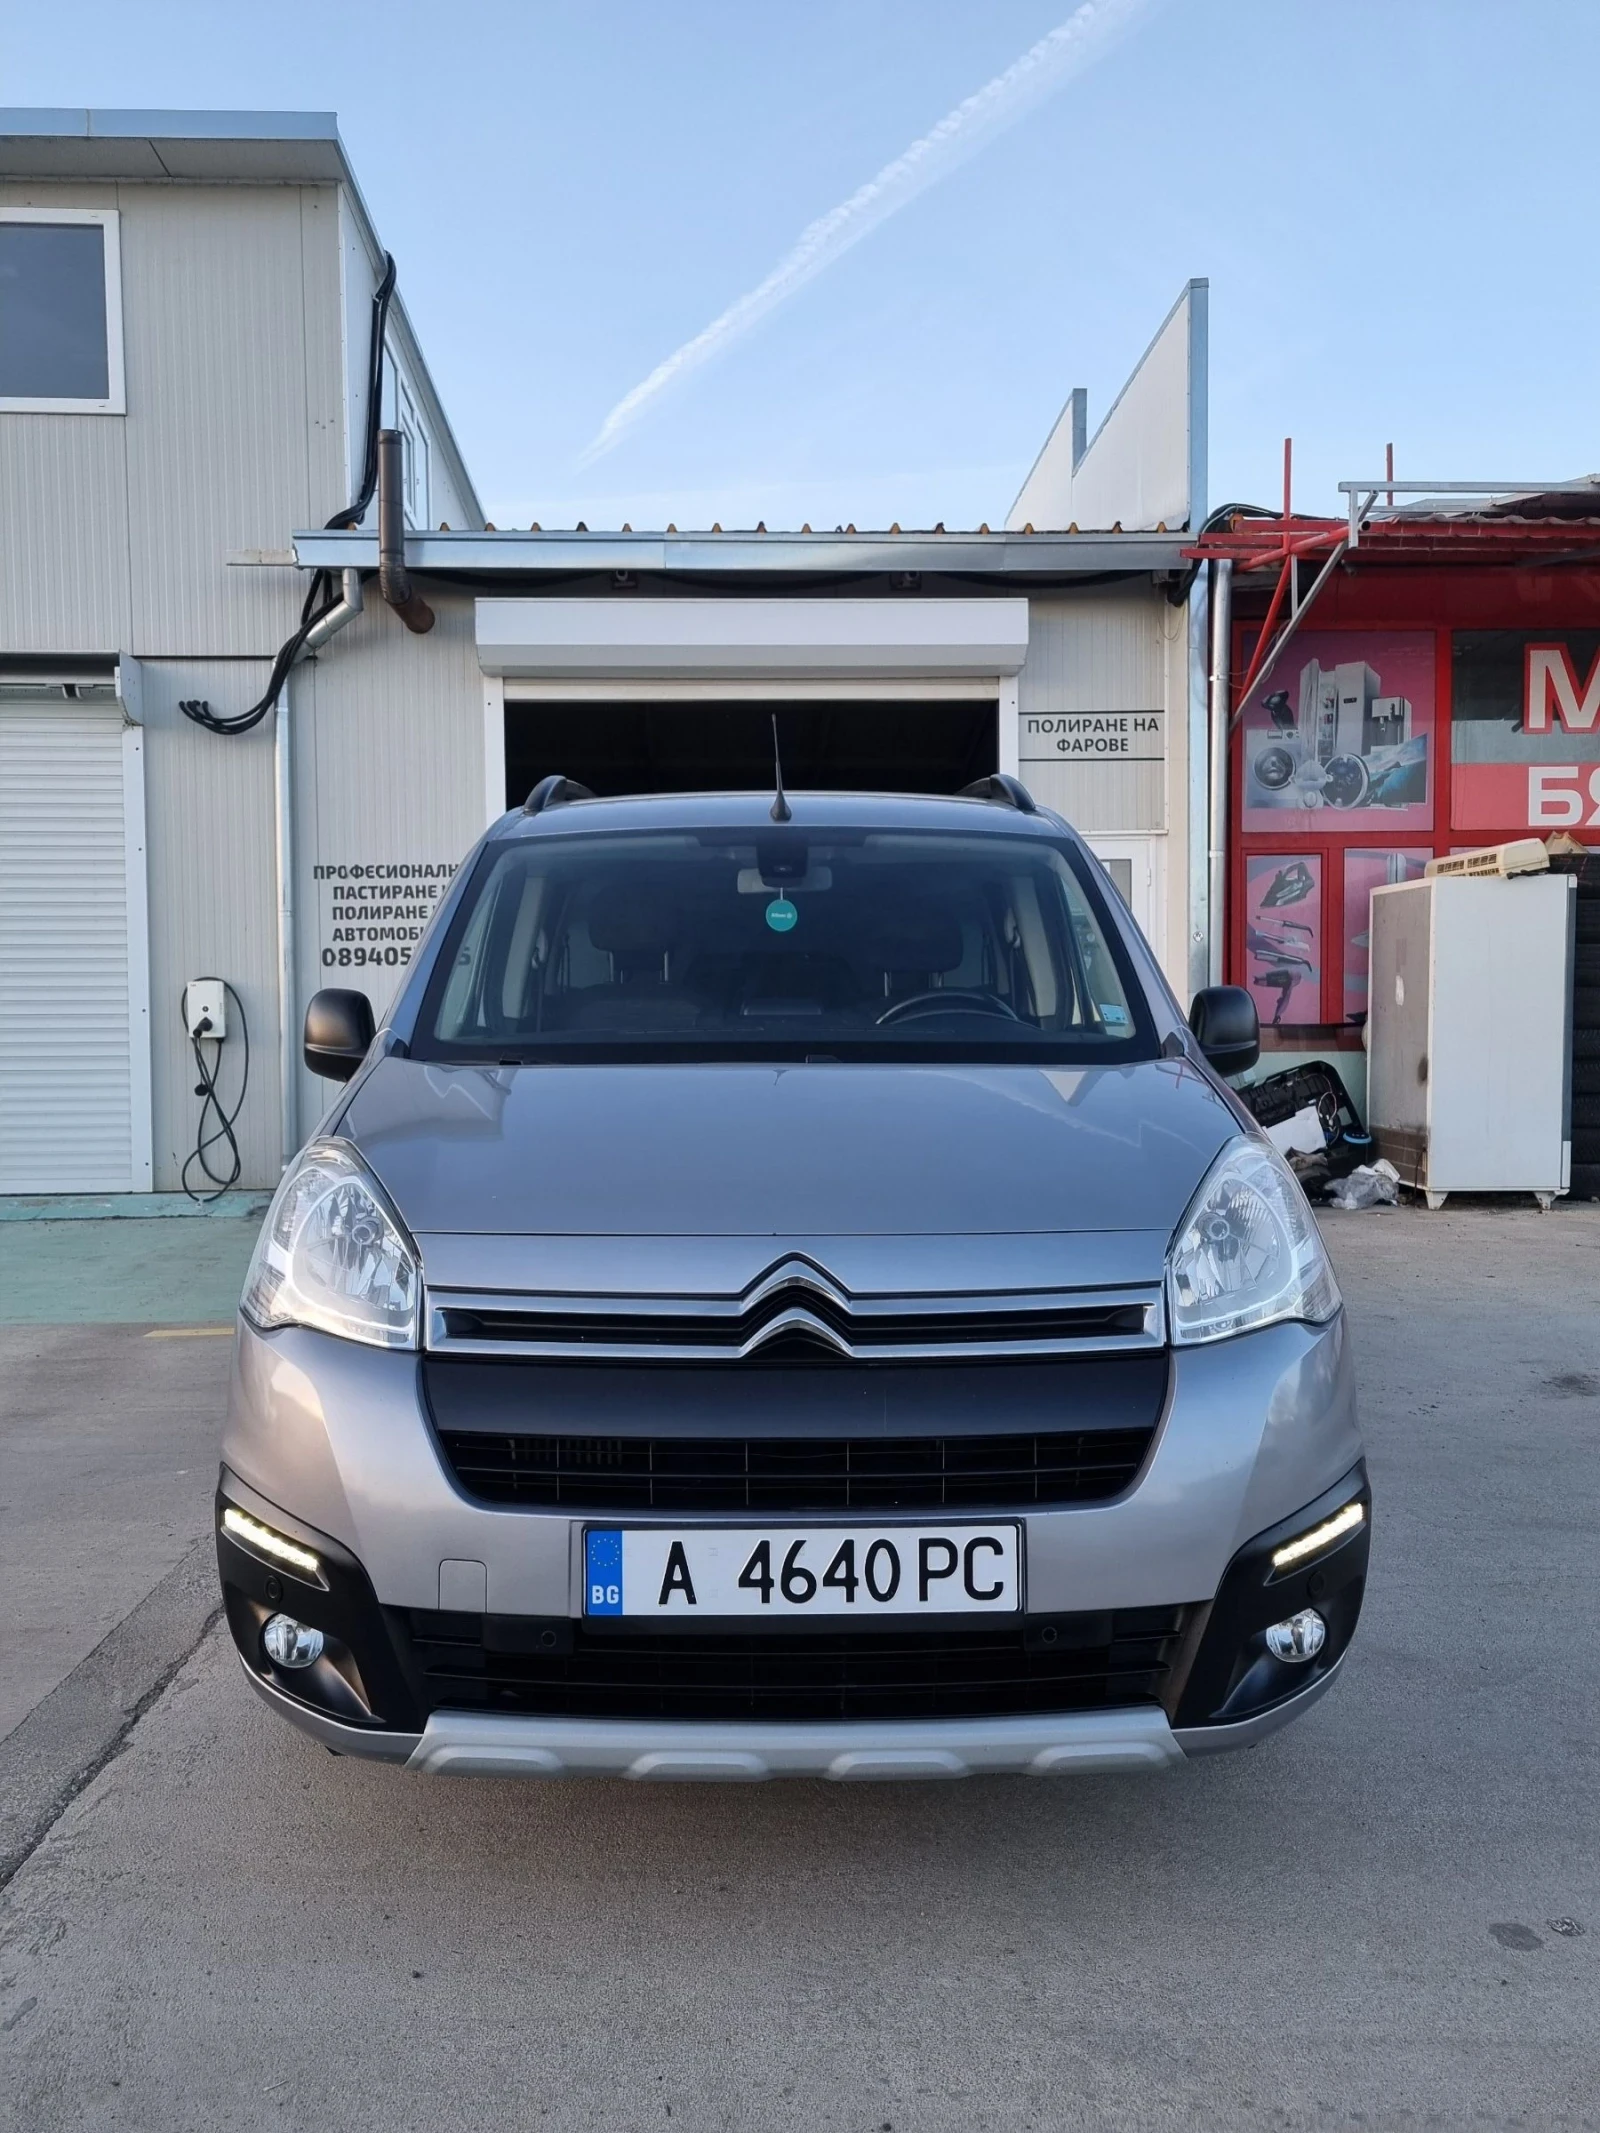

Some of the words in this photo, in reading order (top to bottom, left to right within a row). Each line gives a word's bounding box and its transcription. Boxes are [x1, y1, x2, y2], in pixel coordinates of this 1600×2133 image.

[1028, 718, 1128, 733] ПОЛИРАНЕ
[1134, 717, 1159, 732] НА
[1056, 737, 1129, 752] ФАРОВЕ
[1528, 766, 1600, 827] Б
[333, 884, 437, 900] ПАСТИРАНЕ
[332, 904, 428, 920] ПОЛИРАНЕ
[322, 946, 415, 967] 089405
[591, 1586, 619, 1605] BG
[658, 1540, 697, 1605] A
[738, 1537, 901, 1604] 4640
[918, 1536, 1004, 1602] PC
